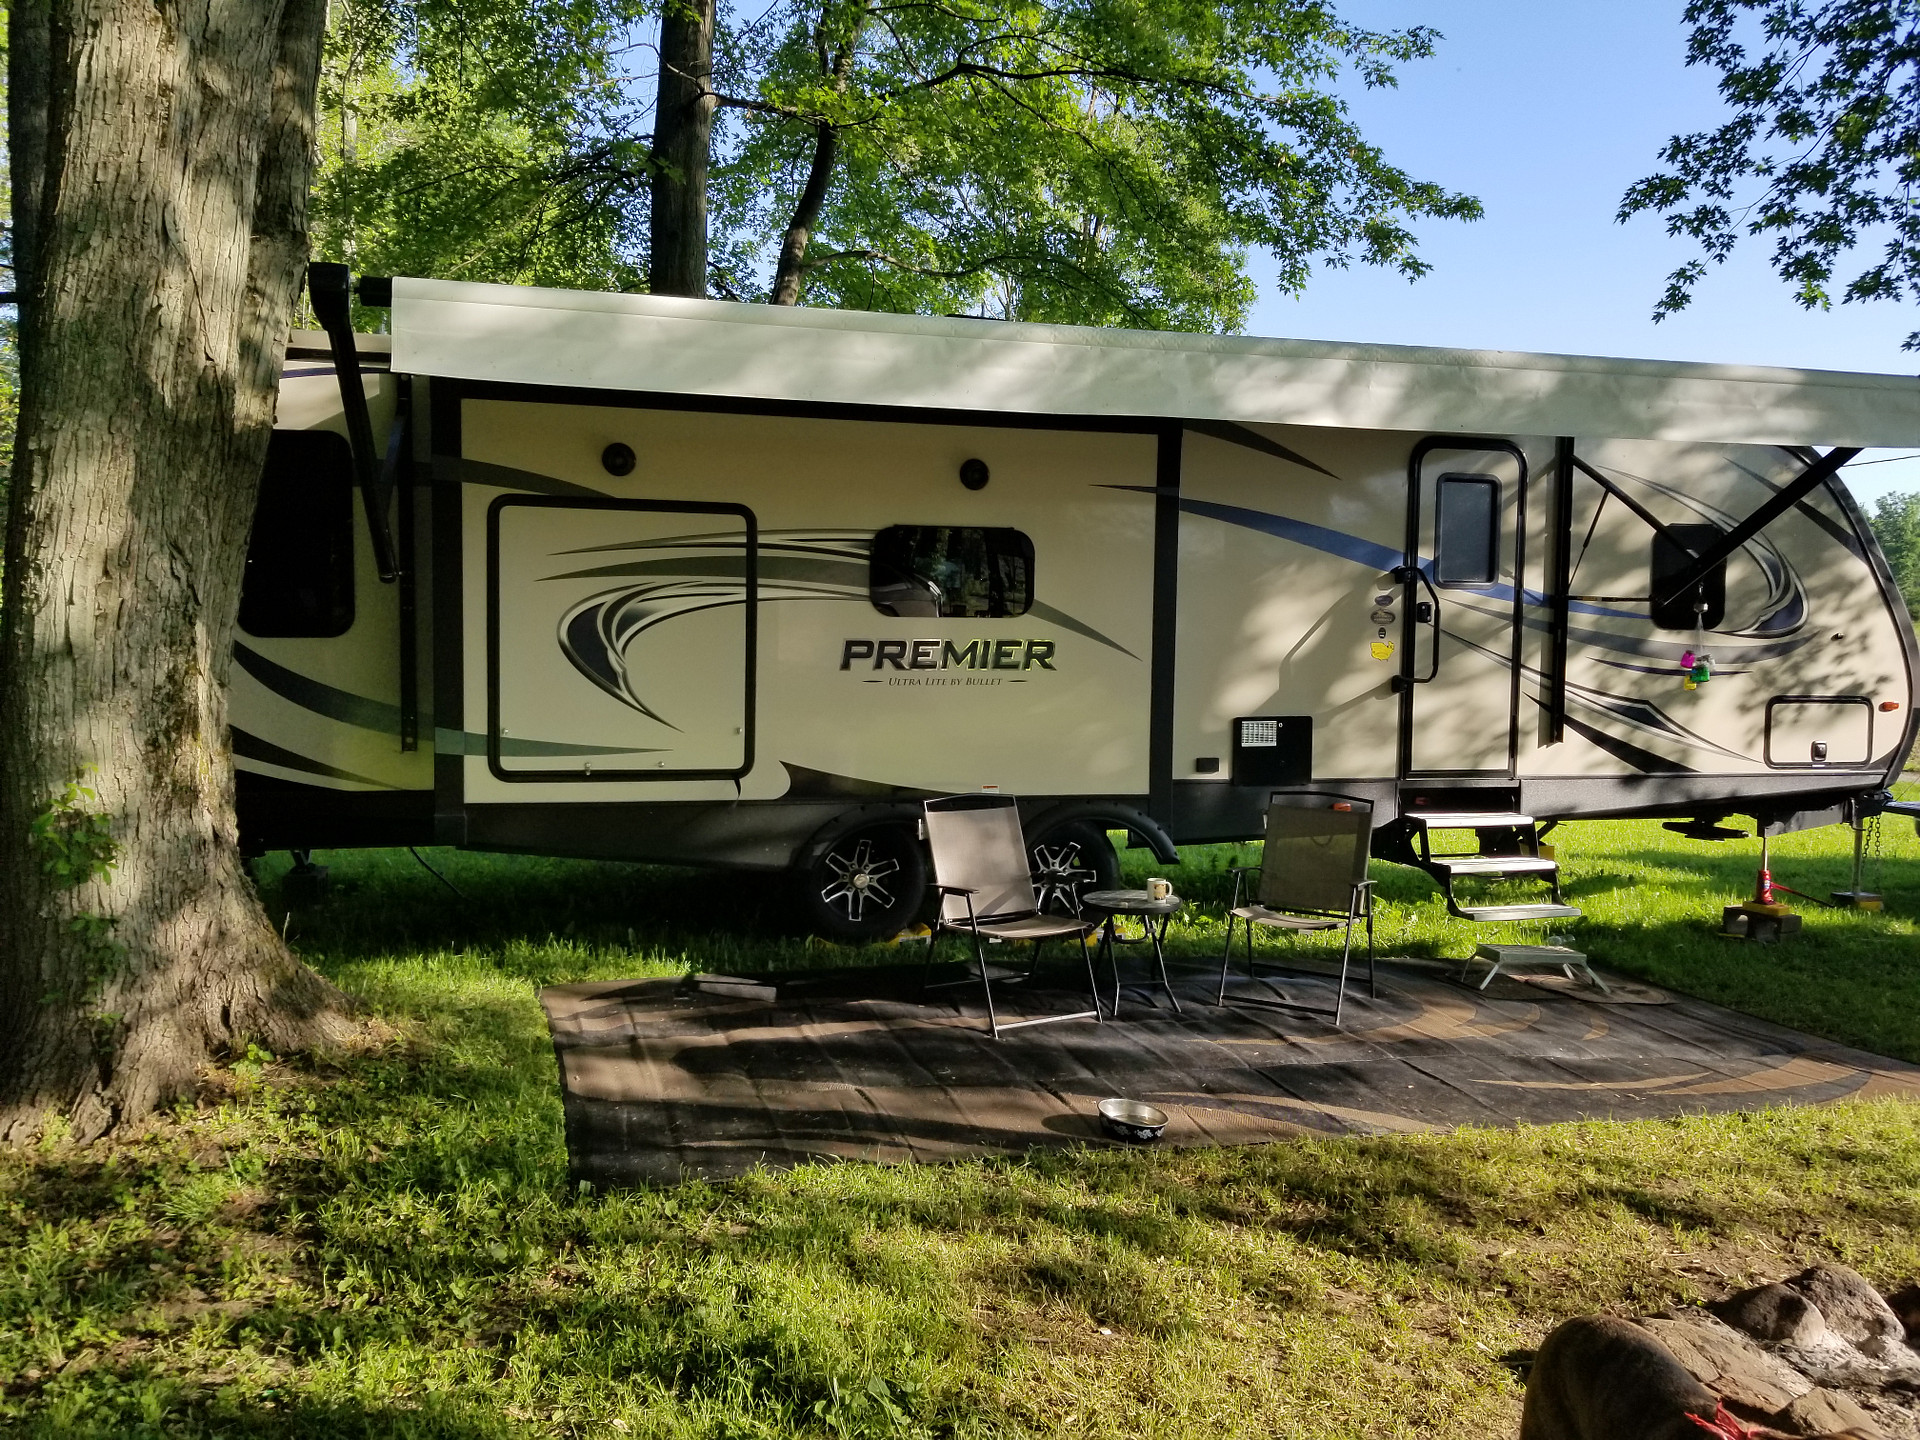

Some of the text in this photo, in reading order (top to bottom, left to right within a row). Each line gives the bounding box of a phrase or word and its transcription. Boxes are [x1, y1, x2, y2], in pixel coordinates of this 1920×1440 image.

[839, 638, 1057, 672] PREMIER
[888, 677, 1003, 687] ULTRA LITE BY BULLET
